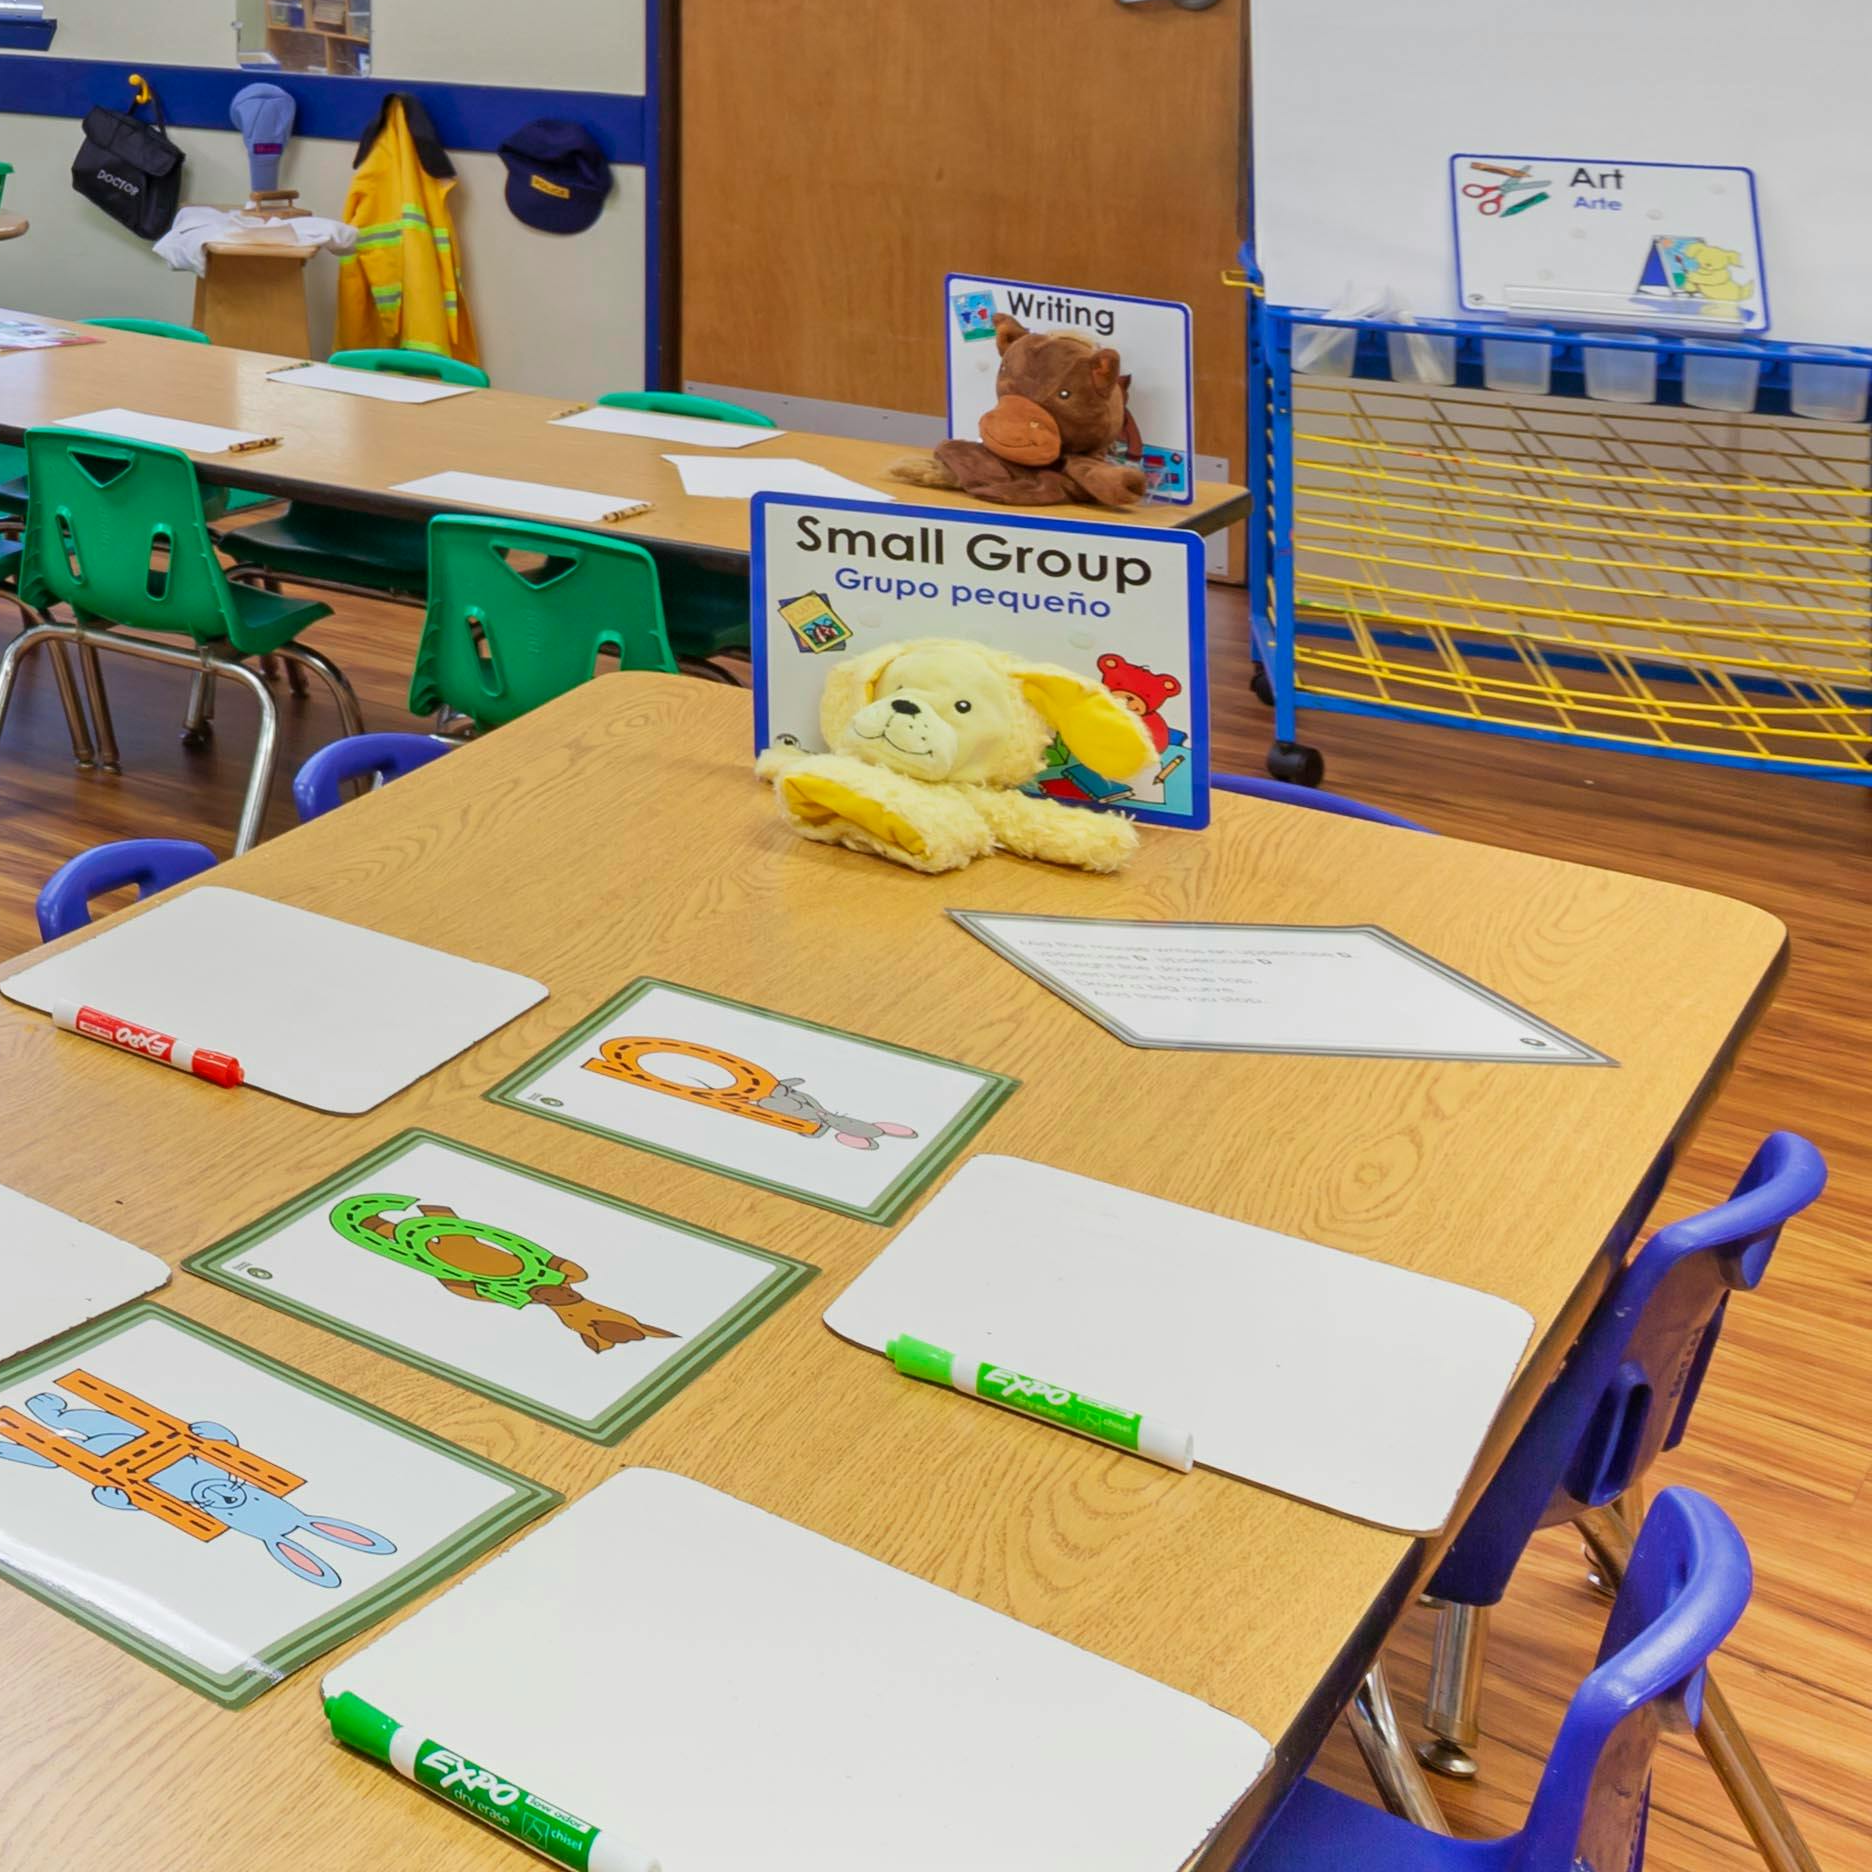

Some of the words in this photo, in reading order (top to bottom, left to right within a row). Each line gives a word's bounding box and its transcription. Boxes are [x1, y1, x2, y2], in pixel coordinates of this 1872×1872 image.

[1568, 166, 1624, 192] Art
[1574, 194, 1623, 214] Arte
[1007, 289, 1115, 335] Writing
[796, 515, 944, 565] Small
[966, 533, 1153, 594] Group
[835, 567, 939, 601] Grupo
[952, 583, 1112, 619] pequeño
[116, 1027, 171, 1057] EXPO
[984, 1367, 1072, 1406] EXPO
[422, 1749, 521, 1807] EXPO
[454, 1787, 476, 1809] dry
[477, 1801, 511, 1826] erase
[529, 1795, 553, 1814] low
[554, 1808, 584, 1829] odor
[550, 1828, 584, 1852] chisel
